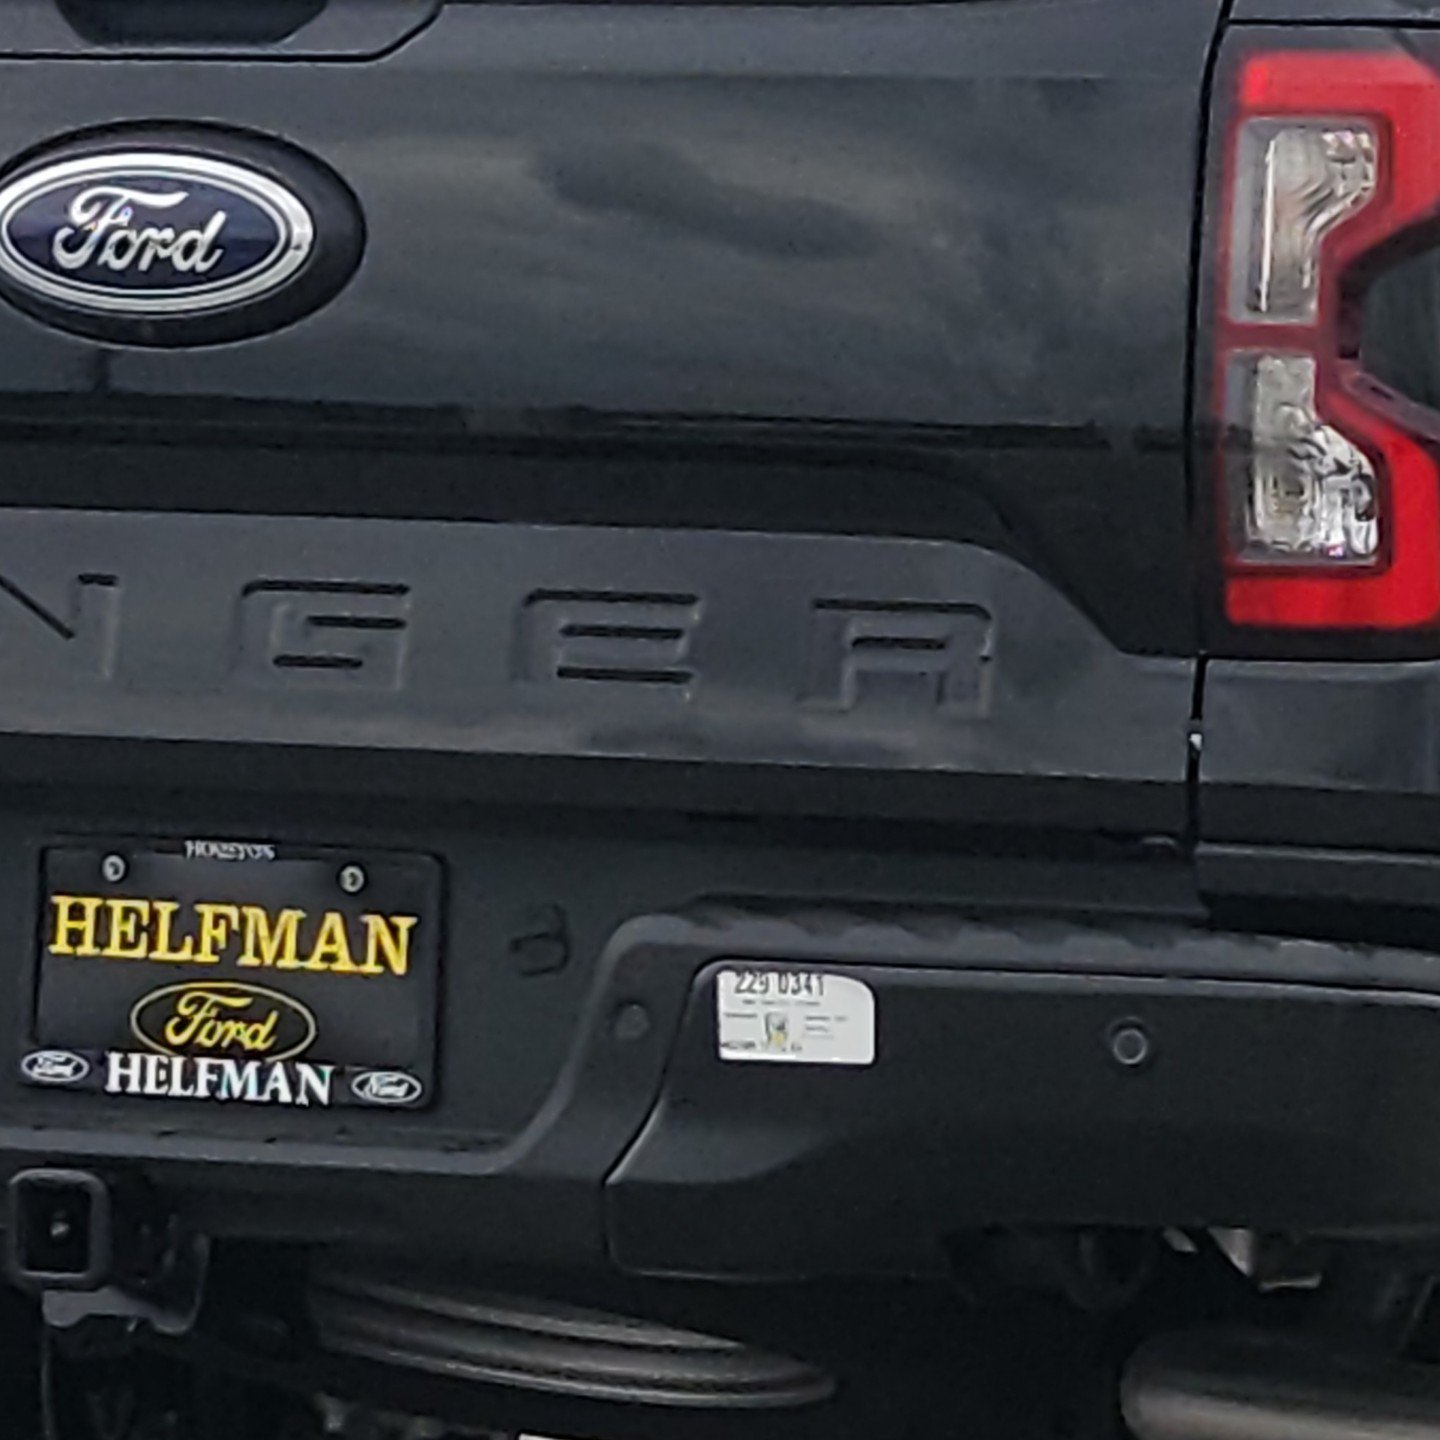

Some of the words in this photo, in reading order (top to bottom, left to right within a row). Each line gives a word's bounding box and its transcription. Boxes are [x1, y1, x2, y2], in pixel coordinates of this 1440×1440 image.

[52, 185, 228, 273] Ford
[48, 894, 418, 976] HELFMAN
[163, 990, 280, 1052] Ford
[104, 1050, 336, 1106] HELFMAN
